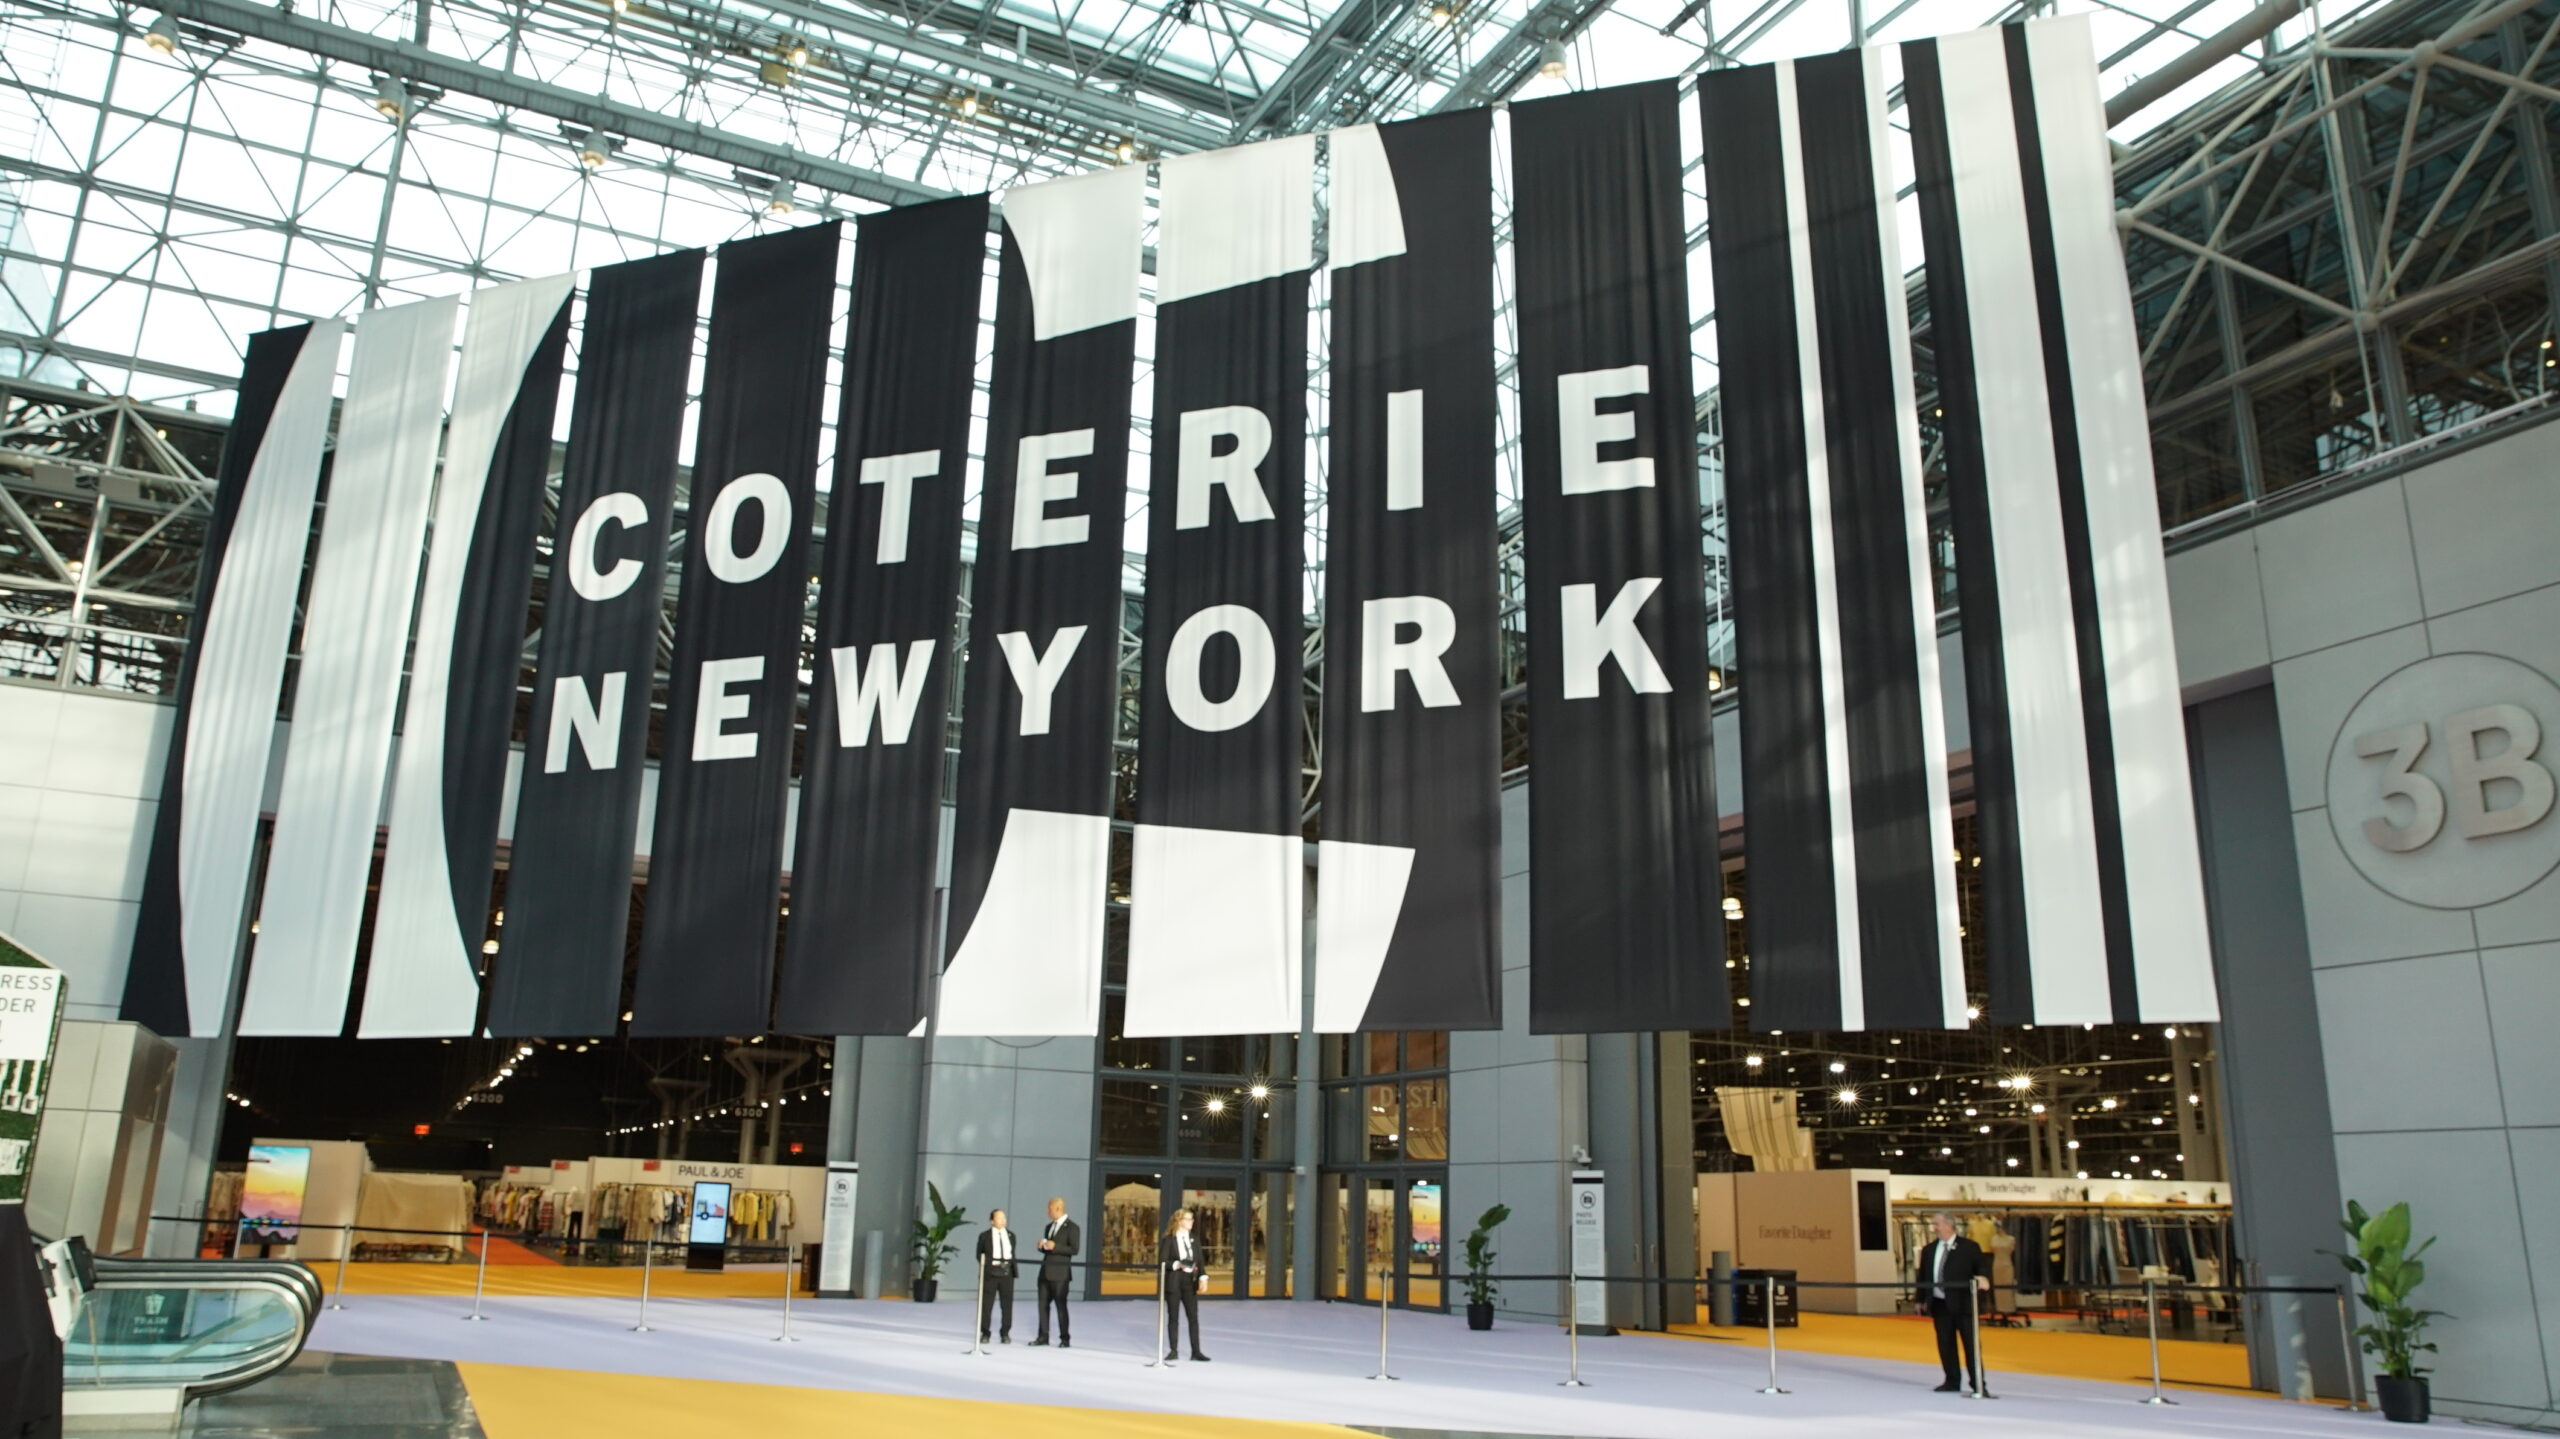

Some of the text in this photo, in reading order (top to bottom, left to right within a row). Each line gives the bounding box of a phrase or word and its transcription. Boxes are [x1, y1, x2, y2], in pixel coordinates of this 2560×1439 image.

[569, 365, 1655, 601] COTERIE
[545, 578, 1672, 773] NEW YORK
[2354, 703, 2556, 854] 3B
[678, 1165, 744, 1179] PAUL & JOE
